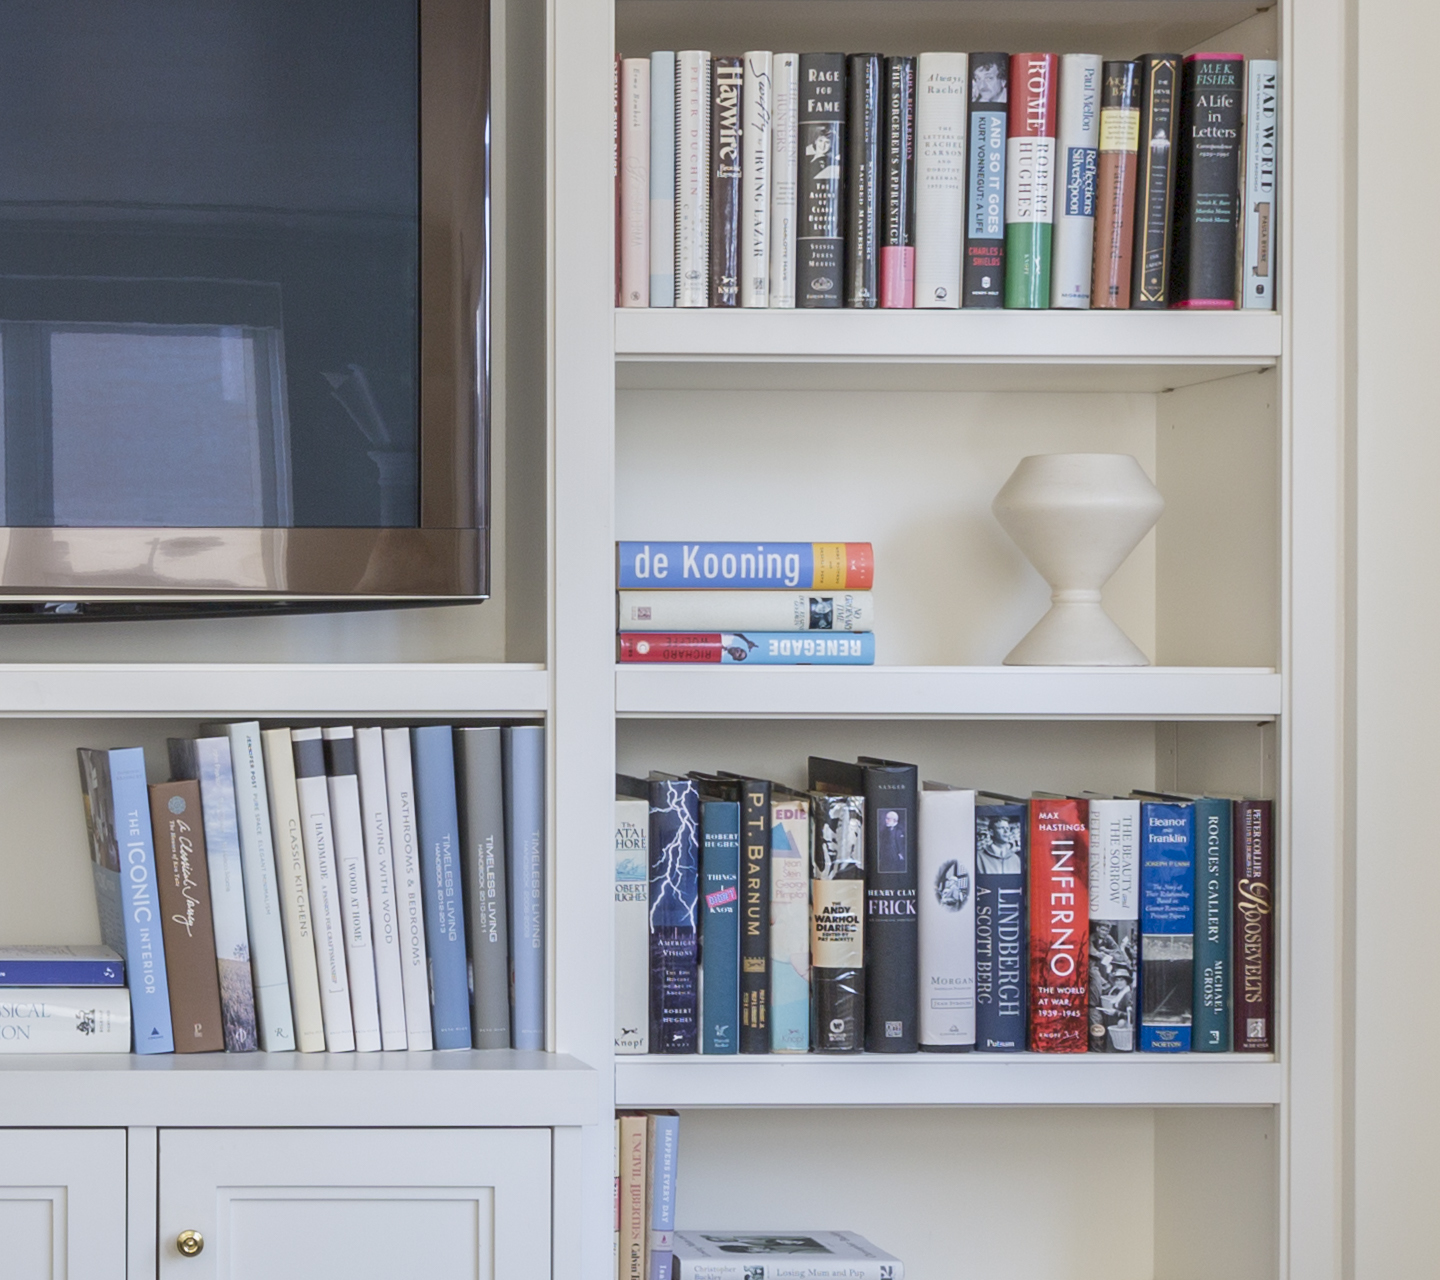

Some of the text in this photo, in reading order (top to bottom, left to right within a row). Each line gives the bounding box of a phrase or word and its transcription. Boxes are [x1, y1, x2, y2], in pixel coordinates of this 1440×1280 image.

[716, 67, 743, 160] Haywire
[1026, 60, 1046, 131] ROME
[988, 117, 1001, 234] AND SO IT GOES
[1018, 142, 1032, 218] HUGHES
[635, 545, 800, 586] de Kooning
[769, 640, 861, 656] RENEGADE
[127, 809, 155, 994] THE ICONIC INTERIOR
[486, 835, 497, 942] TIMELESS LIVING
[747, 793, 764, 935] P.T. BARNUM
[868, 900, 916, 915] FRICK
[1051, 840, 1074, 976] INFERNO
[1208, 816, 1219, 943] ROGUES' GALLERY
[815, 915, 859, 924] WARHOL
[977, 905, 992, 1004] SCOTT BERG
[998, 887, 1022, 1016] LINDBERGH
